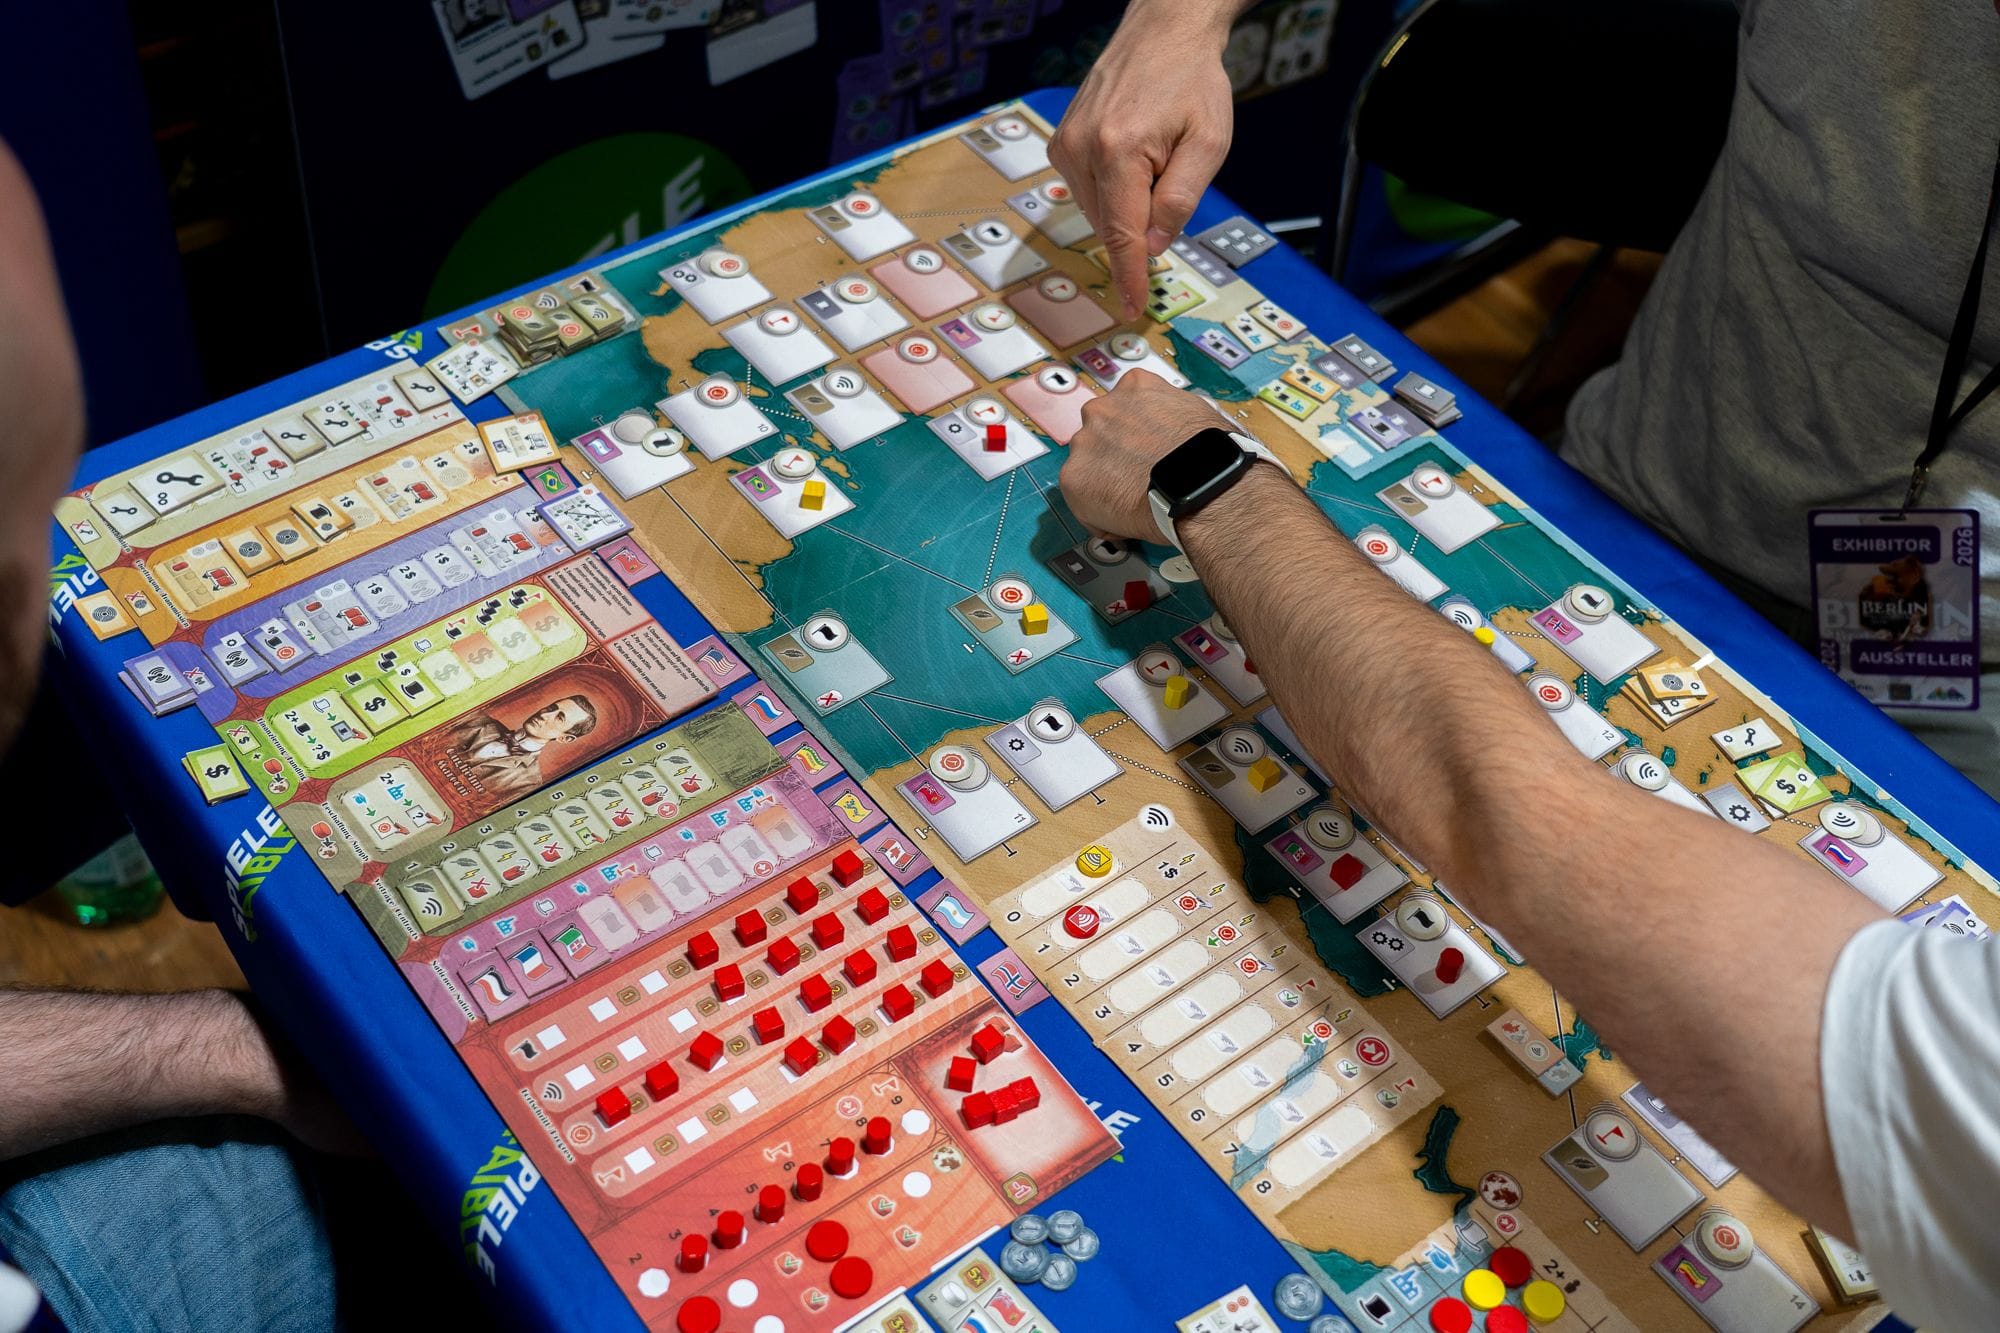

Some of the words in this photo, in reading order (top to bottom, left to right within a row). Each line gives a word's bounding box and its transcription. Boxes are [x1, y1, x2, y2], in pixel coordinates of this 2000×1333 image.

[1832, 537, 1932, 553] EXHIBITOR
[1957, 528, 1974, 567] 2026
[1861, 600, 1928, 616] BERLIN
[1858, 651, 1973, 667] AUSSTELLER
[656, 742, 667, 750] 8
[621, 758, 633, 766] 7
[433, 755, 471, 797] Marconi
[587, 775, 598, 783] 6
[552, 792, 564, 800] 5
[517, 809, 528, 818] 4
[480, 825, 492, 835] 3
[443, 842, 455, 852] 2
[1007, 911, 1021, 923] 0
[1037, 943, 1050, 953] 1
[1065, 974, 1080, 987] 2
[1095, 1006, 1110, 1019] 3
[1127, 1042, 1142, 1052] 4
[1157, 1074, 1174, 1087] 5
[1190, 1109, 1206, 1122] 6
[1224, 1143, 1239, 1156] 7
[1256, 1180, 1271, 1193] 8
[478, 1153, 541, 1288] PIELE
